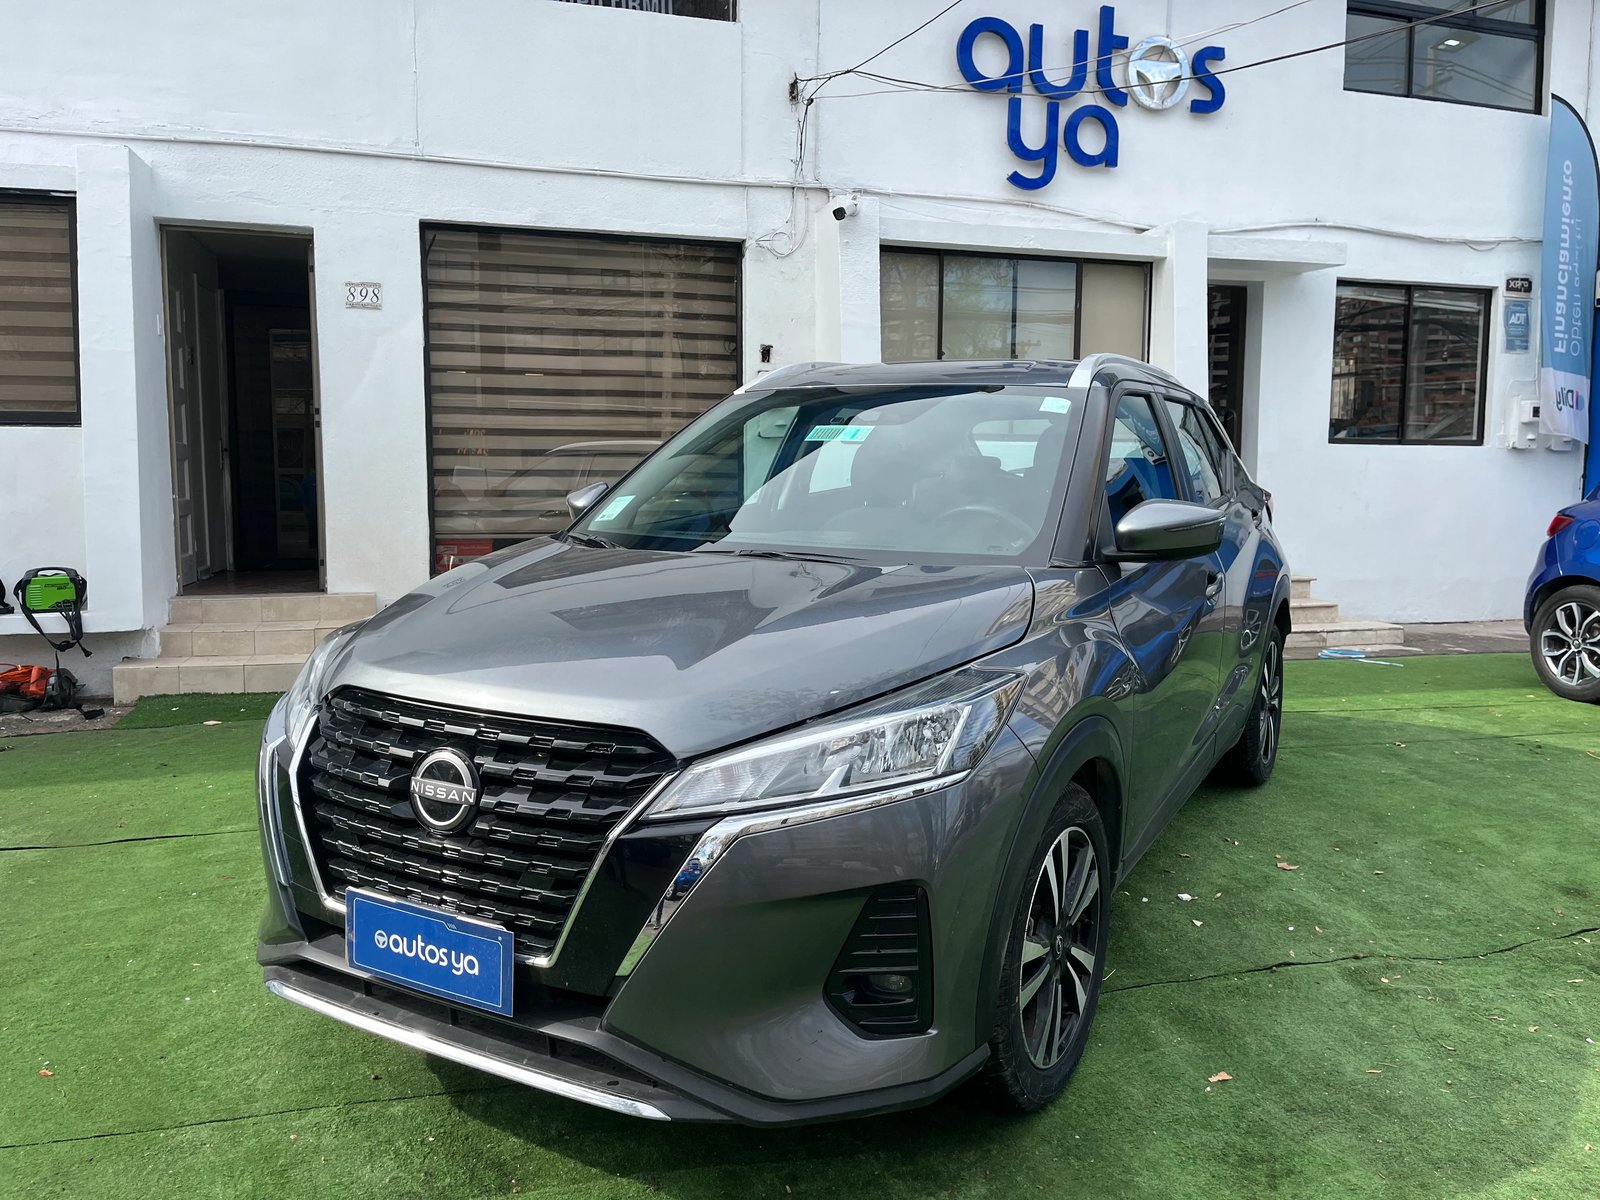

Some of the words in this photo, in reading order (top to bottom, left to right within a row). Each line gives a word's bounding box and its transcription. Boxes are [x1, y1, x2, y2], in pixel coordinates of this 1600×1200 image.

[1007, 97, 1119, 191] ya
[346, 286, 380, 304] 898
[1509, 313, 1527, 325] ADT
[410, 780, 475, 803] NISSAN
[389, 934, 448, 966] autos
[451, 950, 479, 976] ya
